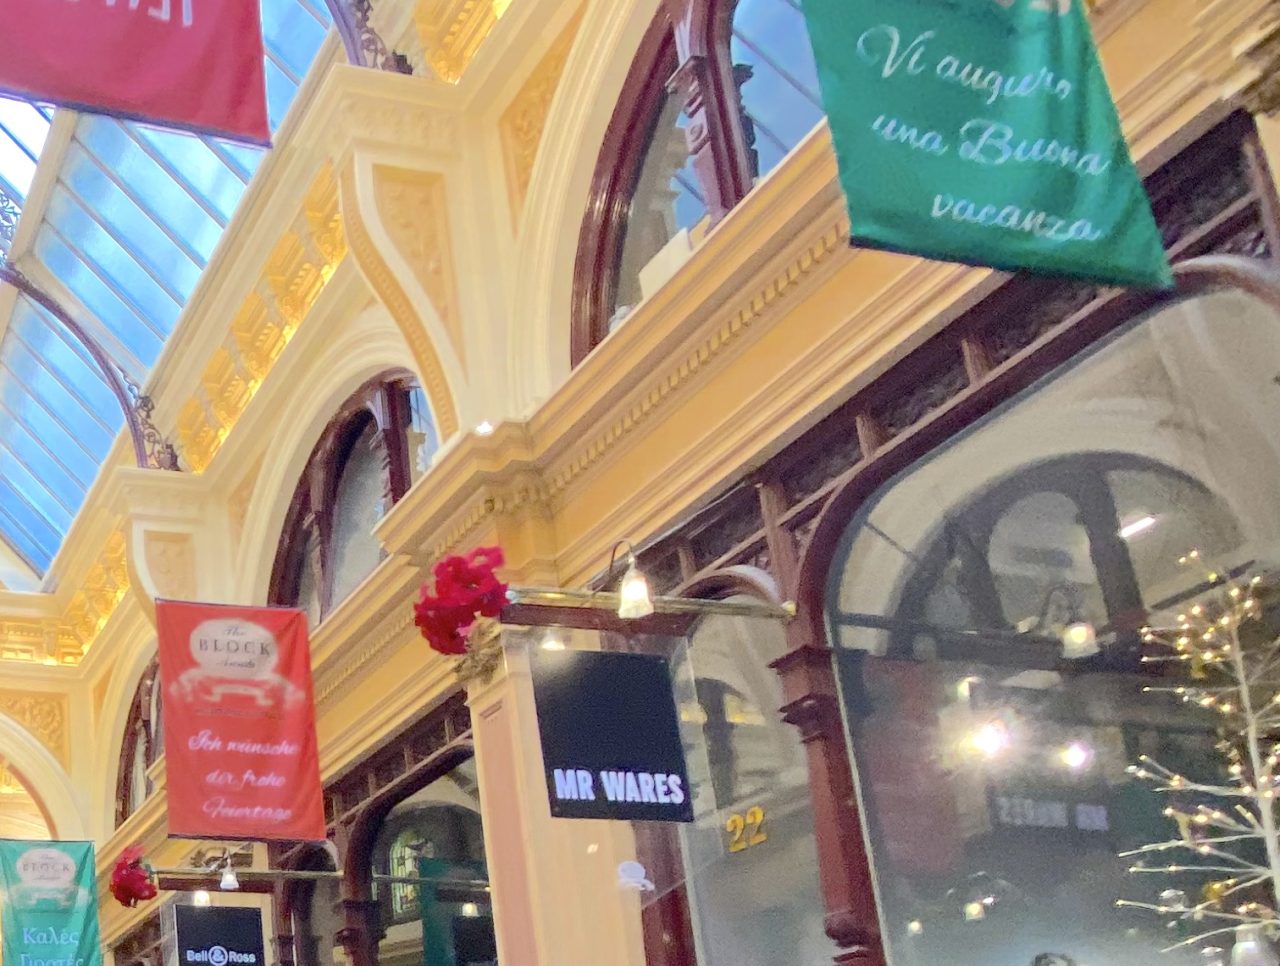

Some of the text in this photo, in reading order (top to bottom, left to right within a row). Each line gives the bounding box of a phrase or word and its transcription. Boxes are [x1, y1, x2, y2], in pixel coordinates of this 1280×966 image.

[857, 25, 934, 77] Vi
[871, 113, 949, 156] una
[932, 193, 1102, 242] vacanza
[200, 638, 270, 656] BLOCK
[553, 768, 685, 804] MR WARES
[726, 806, 768, 853] 22
[186, 950, 208, 962] Bell
[229, 951, 256, 963] Ross
